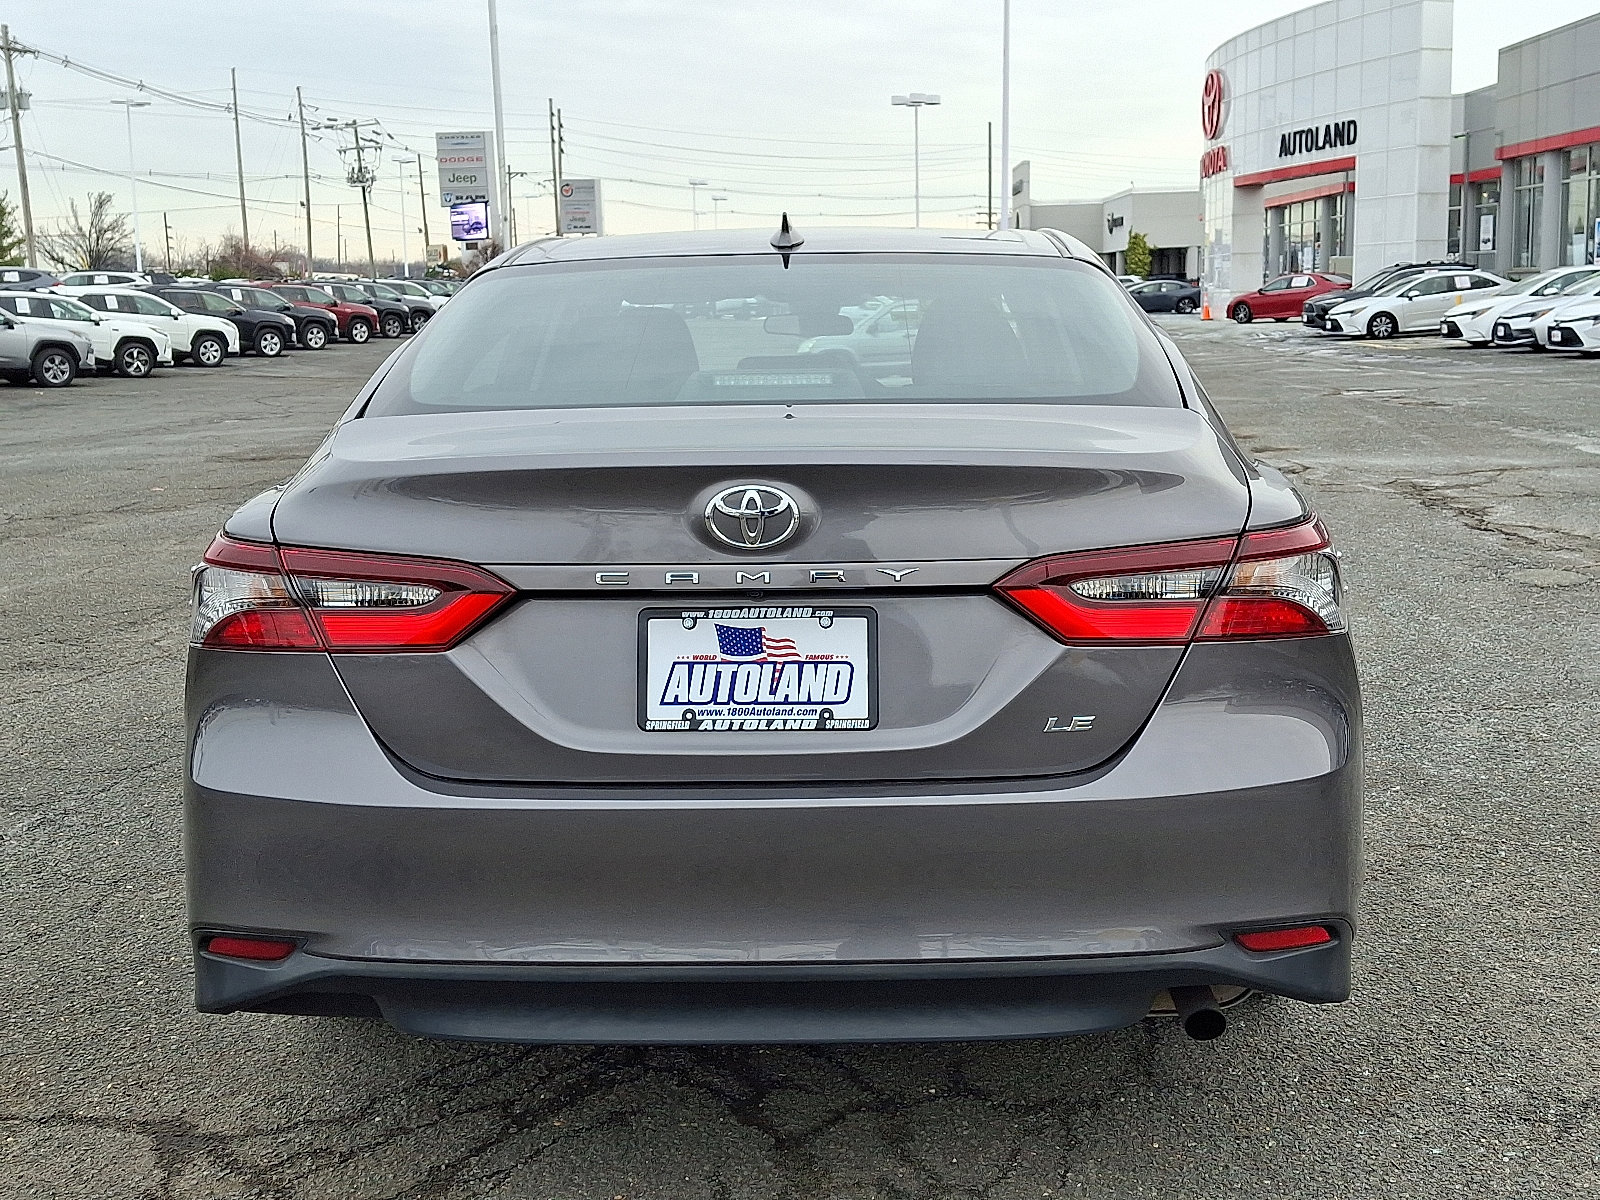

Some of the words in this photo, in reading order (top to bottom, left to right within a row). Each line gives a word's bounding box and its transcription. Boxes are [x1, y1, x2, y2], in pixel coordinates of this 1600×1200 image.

[1278, 119, 1358, 158] AUTOLAND
[1200, 146, 1228, 179] YOTA
[448, 173, 477, 185] Jeep
[595, 566, 920, 586] CAMRY
[681, 607, 834, 619] www.1800AUTOLAND.com
[659, 661, 855, 706] AUTOLAND
[697, 706, 818, 718] www.1800Autoland.com
[645, 720, 691, 731] SPRINGFIELD
[697, 719, 818, 731] AUTOLAND
[825, 719, 870, 730] SPRINGFIELD
[1042, 714, 1096, 733] LE
